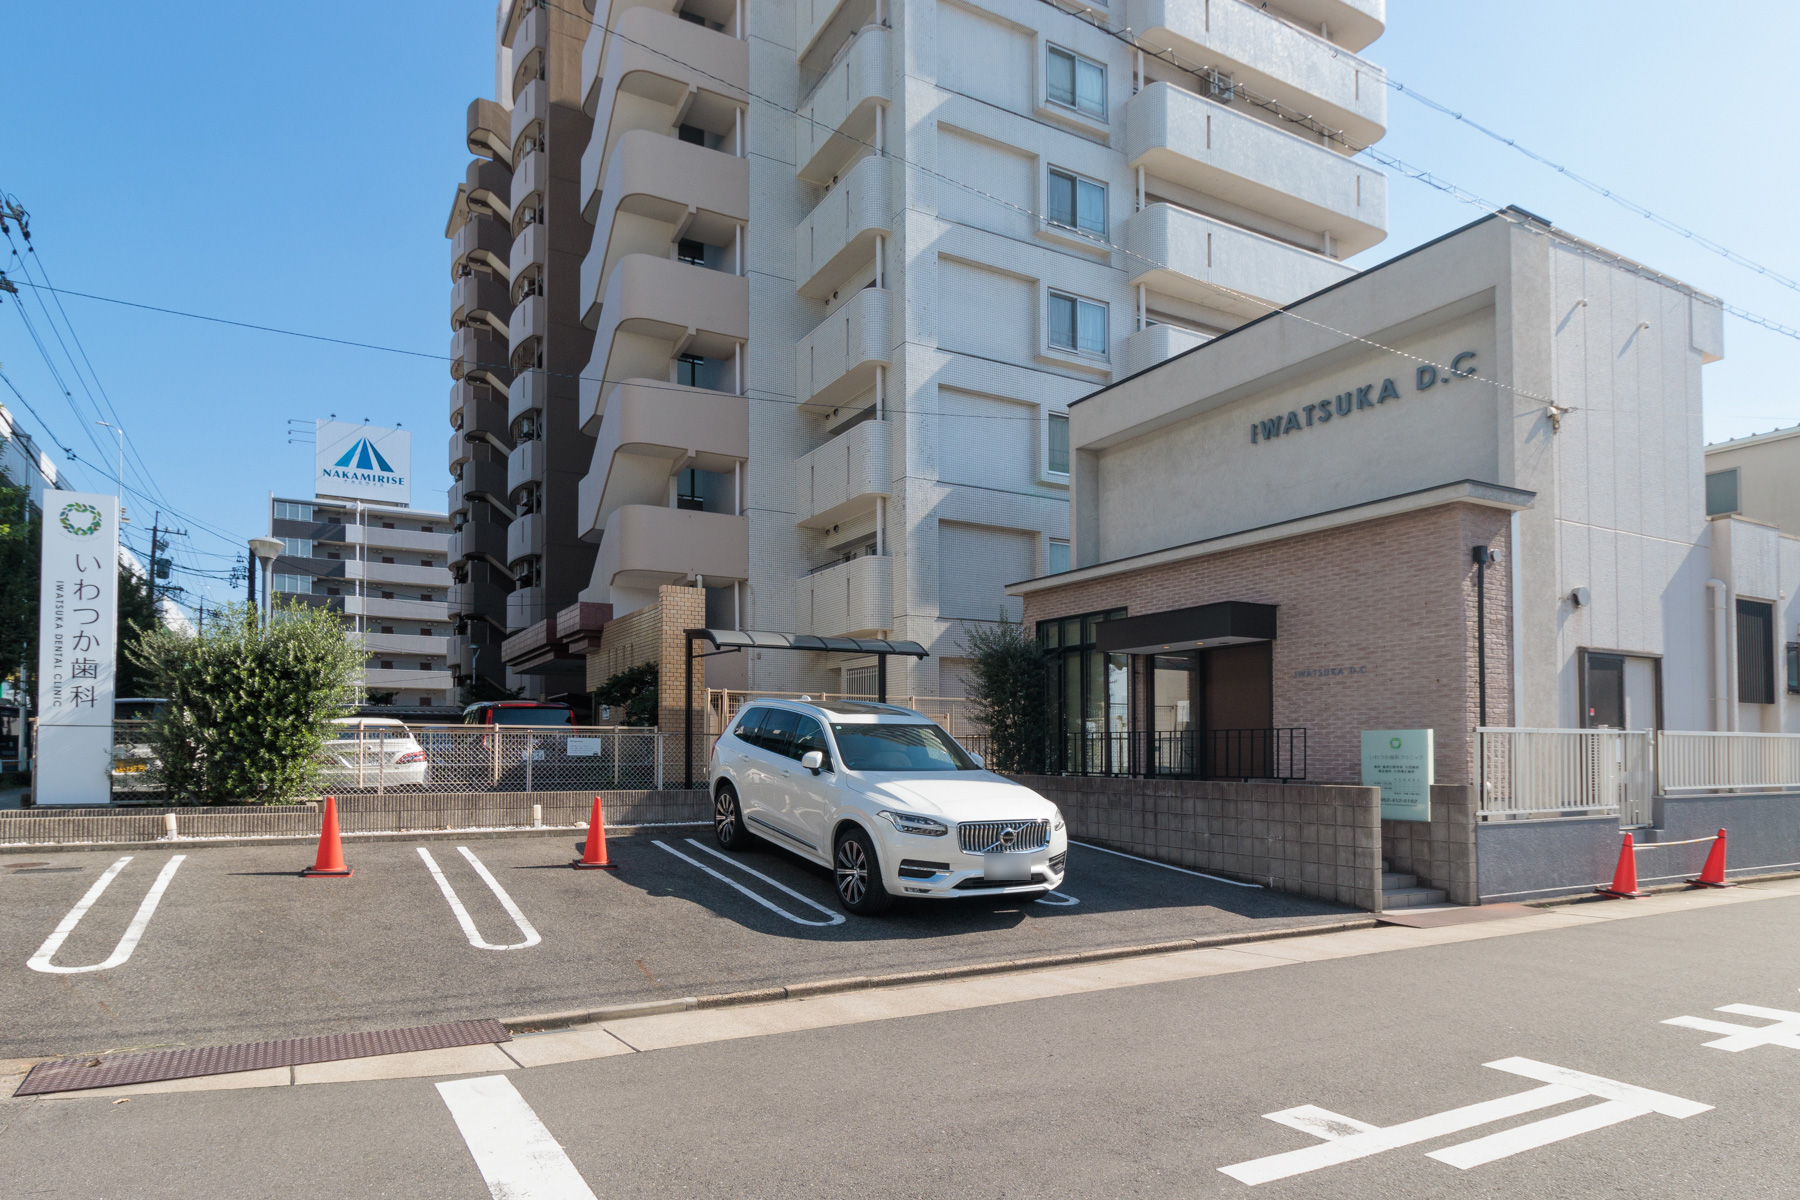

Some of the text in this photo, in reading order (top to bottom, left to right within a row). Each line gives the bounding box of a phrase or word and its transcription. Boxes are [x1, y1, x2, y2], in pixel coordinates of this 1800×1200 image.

[1250, 351, 1477, 444] IWATSUKA D.C
[322, 468, 405, 486] NAKAMIRISE
[53, 580, 65, 707] IWATSUKA DENTAL CLINIC
[70, 553, 102, 709] いわつか歯科
[1294, 666, 1345, 679] IWATSUKA
